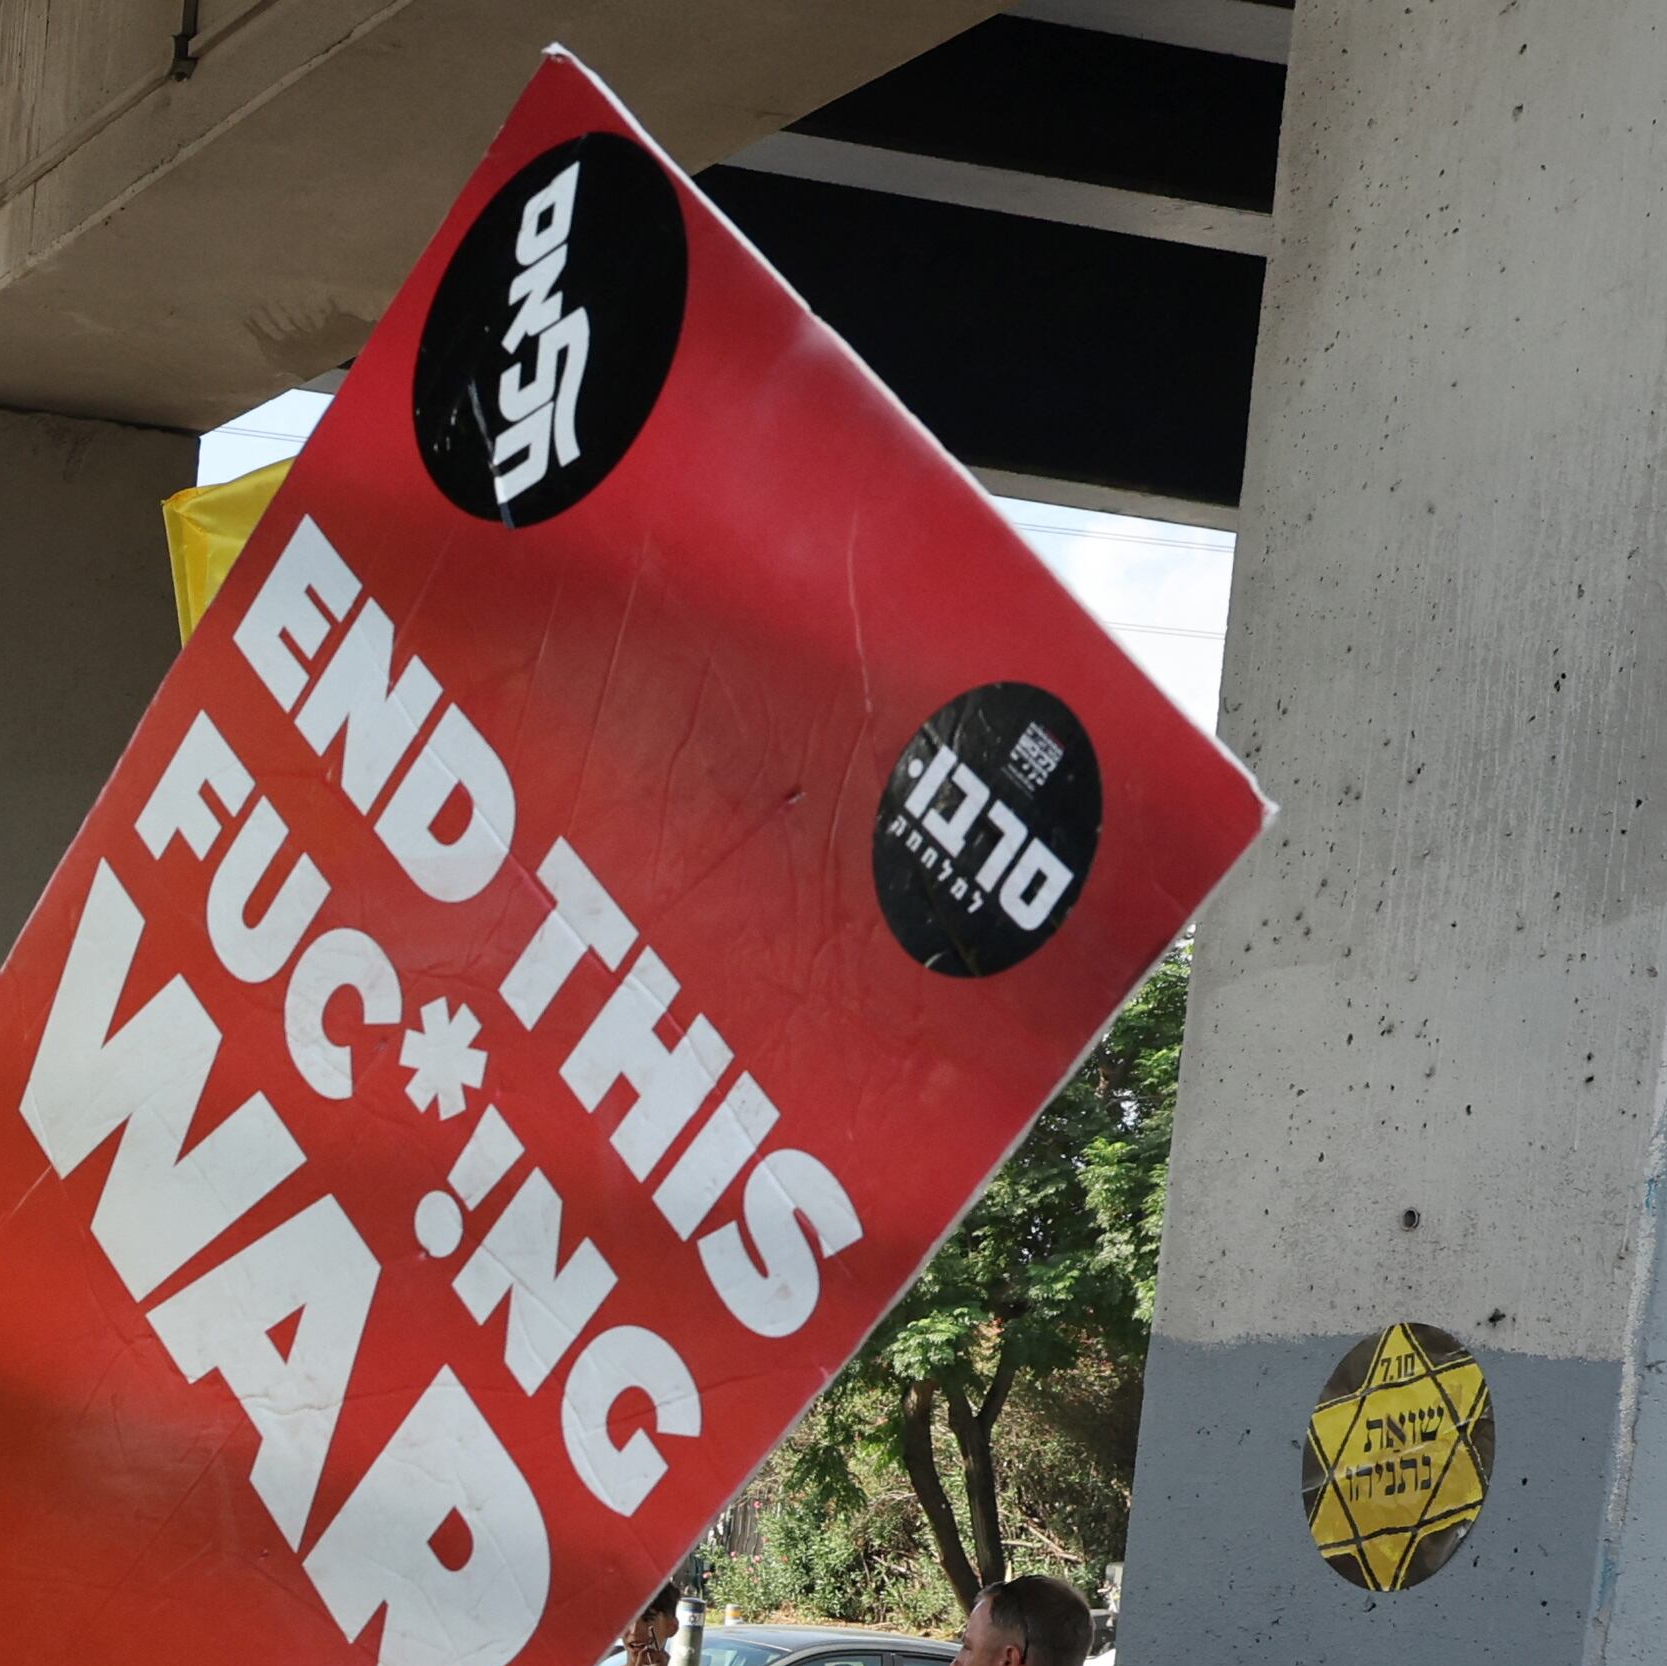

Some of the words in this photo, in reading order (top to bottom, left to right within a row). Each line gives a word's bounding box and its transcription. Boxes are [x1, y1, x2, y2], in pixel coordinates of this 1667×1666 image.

[234, 513, 516, 904] END
[500, 836, 863, 1339] THIS
[1380, 1353, 1415, 1382] 7.10
[1345, 1453, 1432, 1502] נתניהו
